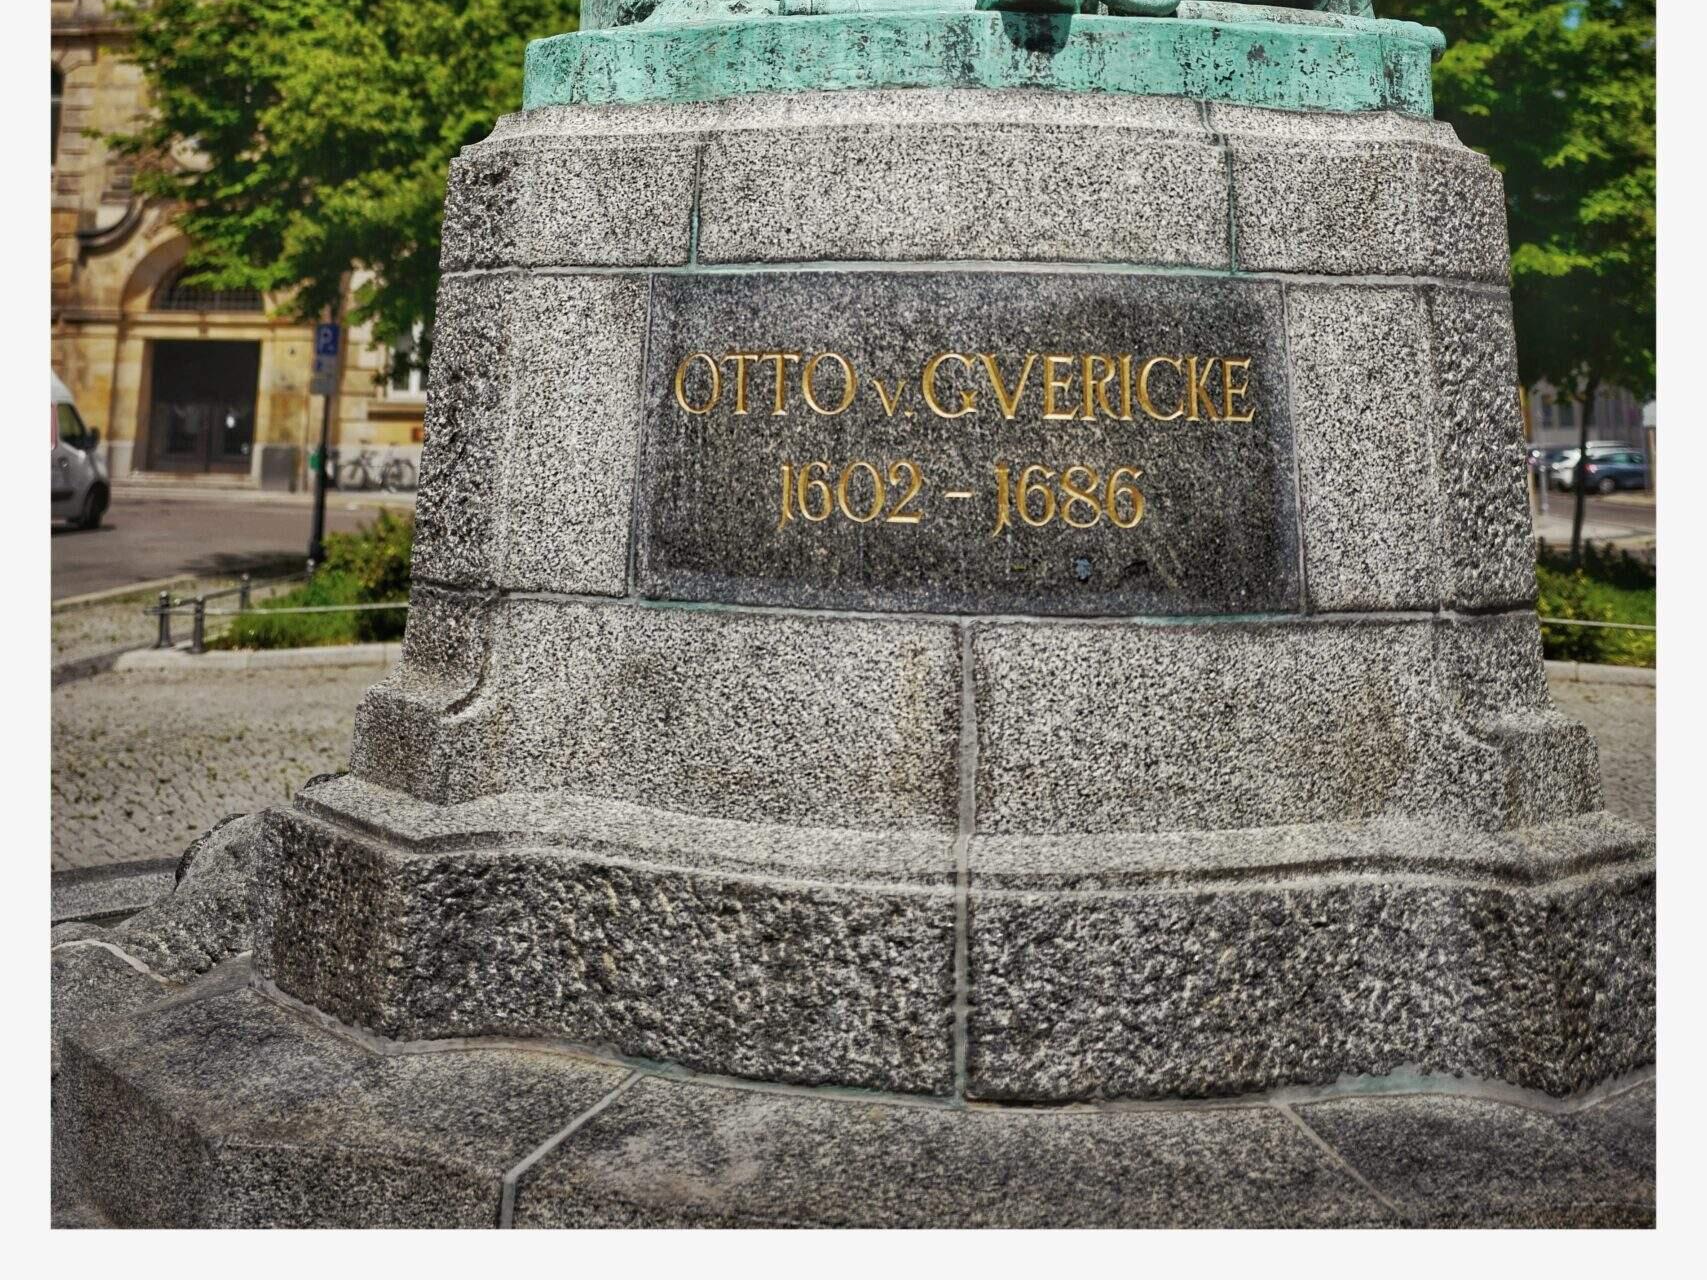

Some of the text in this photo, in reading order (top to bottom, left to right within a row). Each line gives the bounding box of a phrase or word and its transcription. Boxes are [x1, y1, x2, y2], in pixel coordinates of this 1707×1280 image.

[674, 352, 857, 416] OTTO
[922, 353, 1257, 422] GVERICKE
[779, 460, 924, 532] 1602
[994, 464, 1147, 537] 1686
